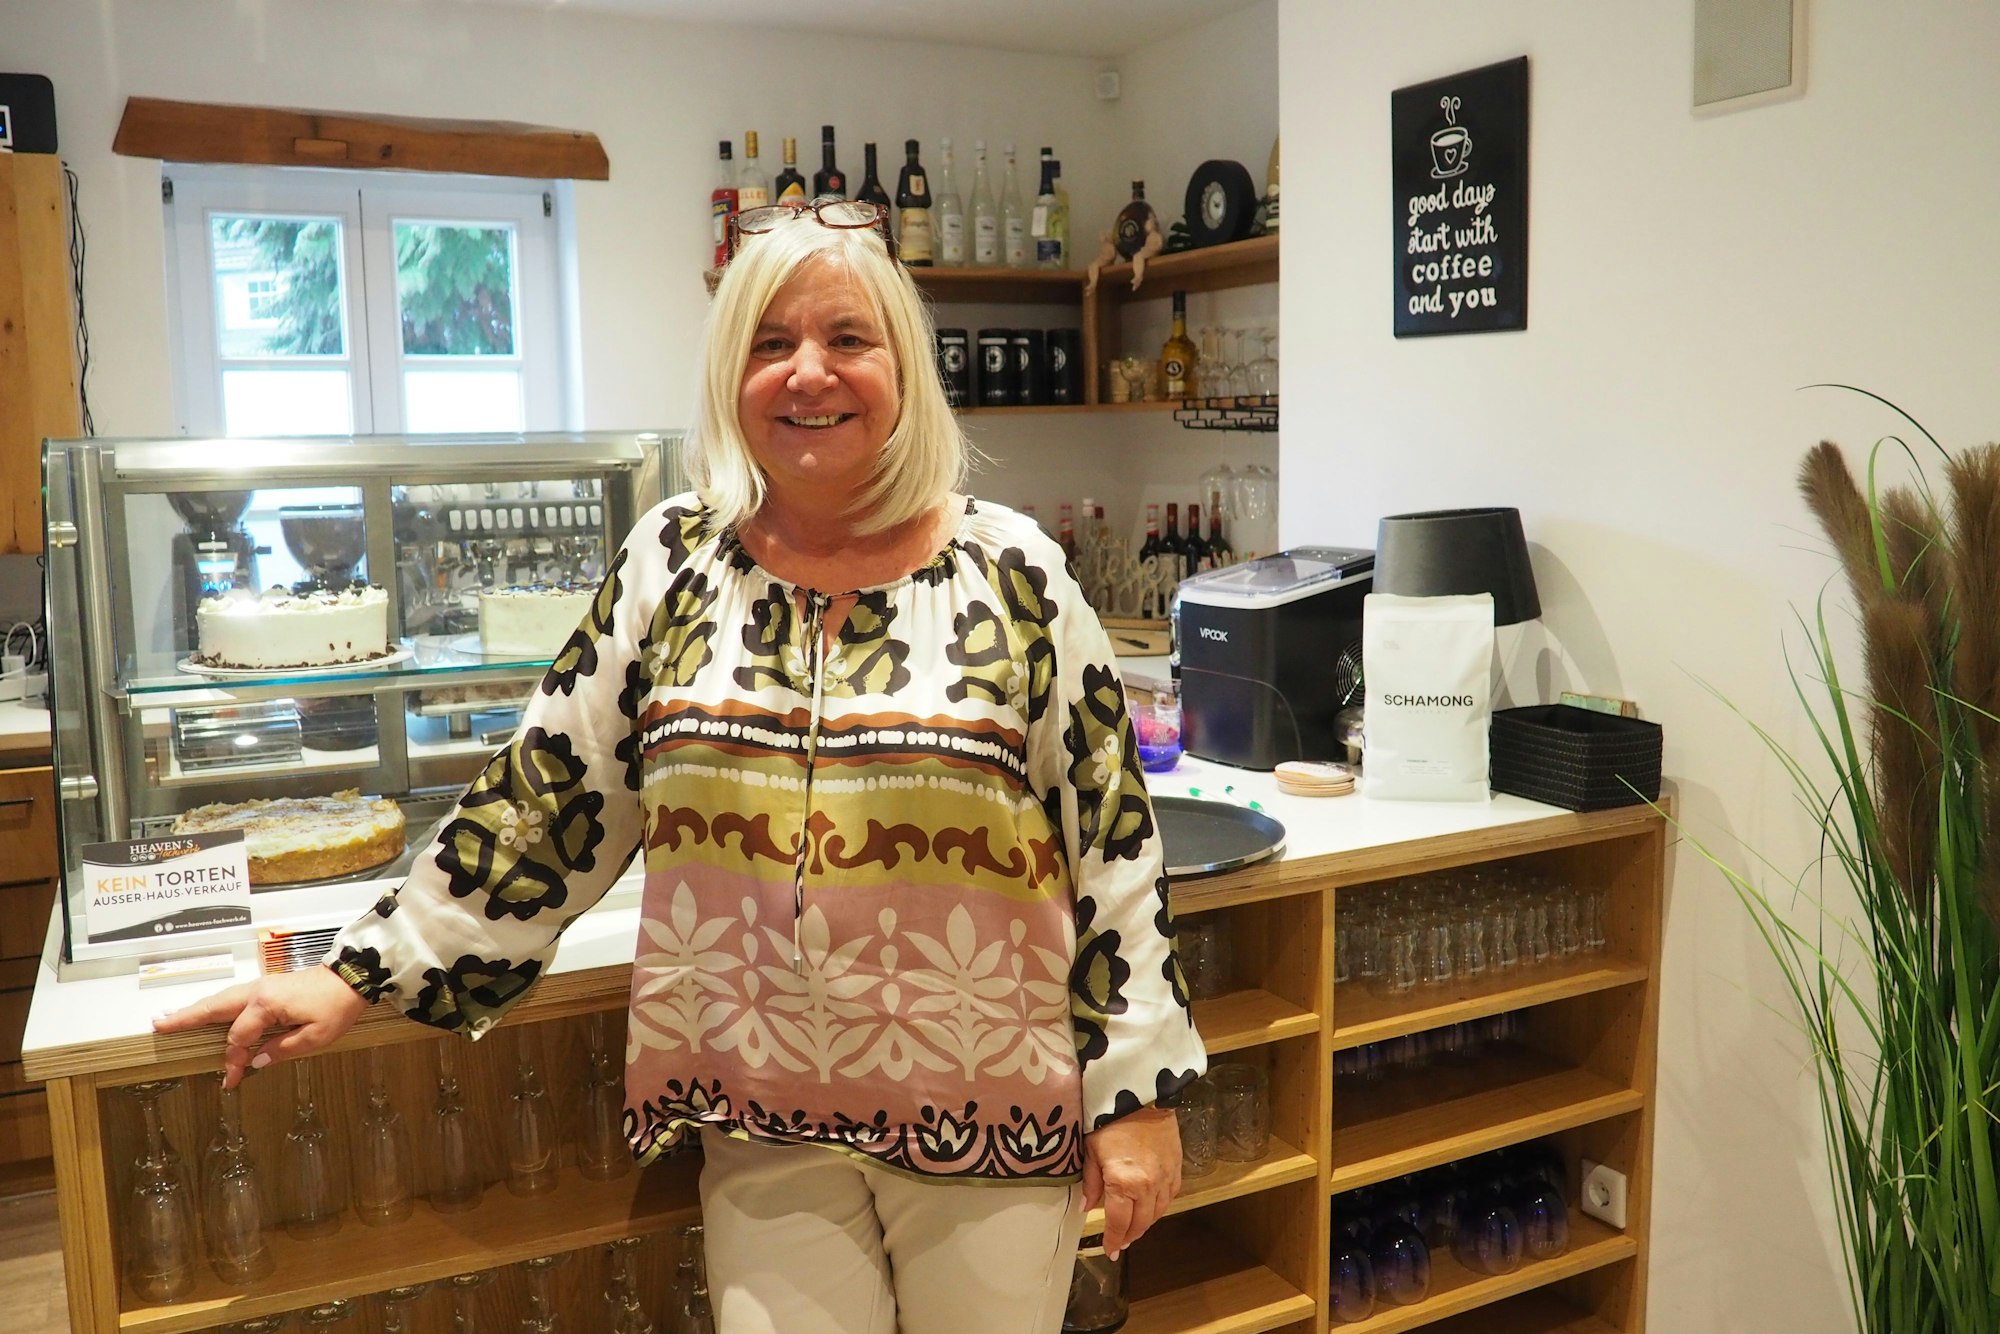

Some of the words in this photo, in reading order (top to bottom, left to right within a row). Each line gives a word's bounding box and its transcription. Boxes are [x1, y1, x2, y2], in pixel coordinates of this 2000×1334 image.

[1408, 182, 1449, 227] good
[1452, 179, 1496, 215] days
[1407, 222, 1451, 254] start
[1454, 214, 1498, 249] with
[1412, 253, 1493, 284] coffee
[1408, 284, 1444, 315] and
[1448, 287, 1497, 318] you
[1384, 694, 1474, 707] SCHAMONG
[93, 881, 242, 907] AUSSER-HAUS-VERKAUF
[97, 875, 148, 893] KEIN
[155, 865, 236, 887] TORTEN
